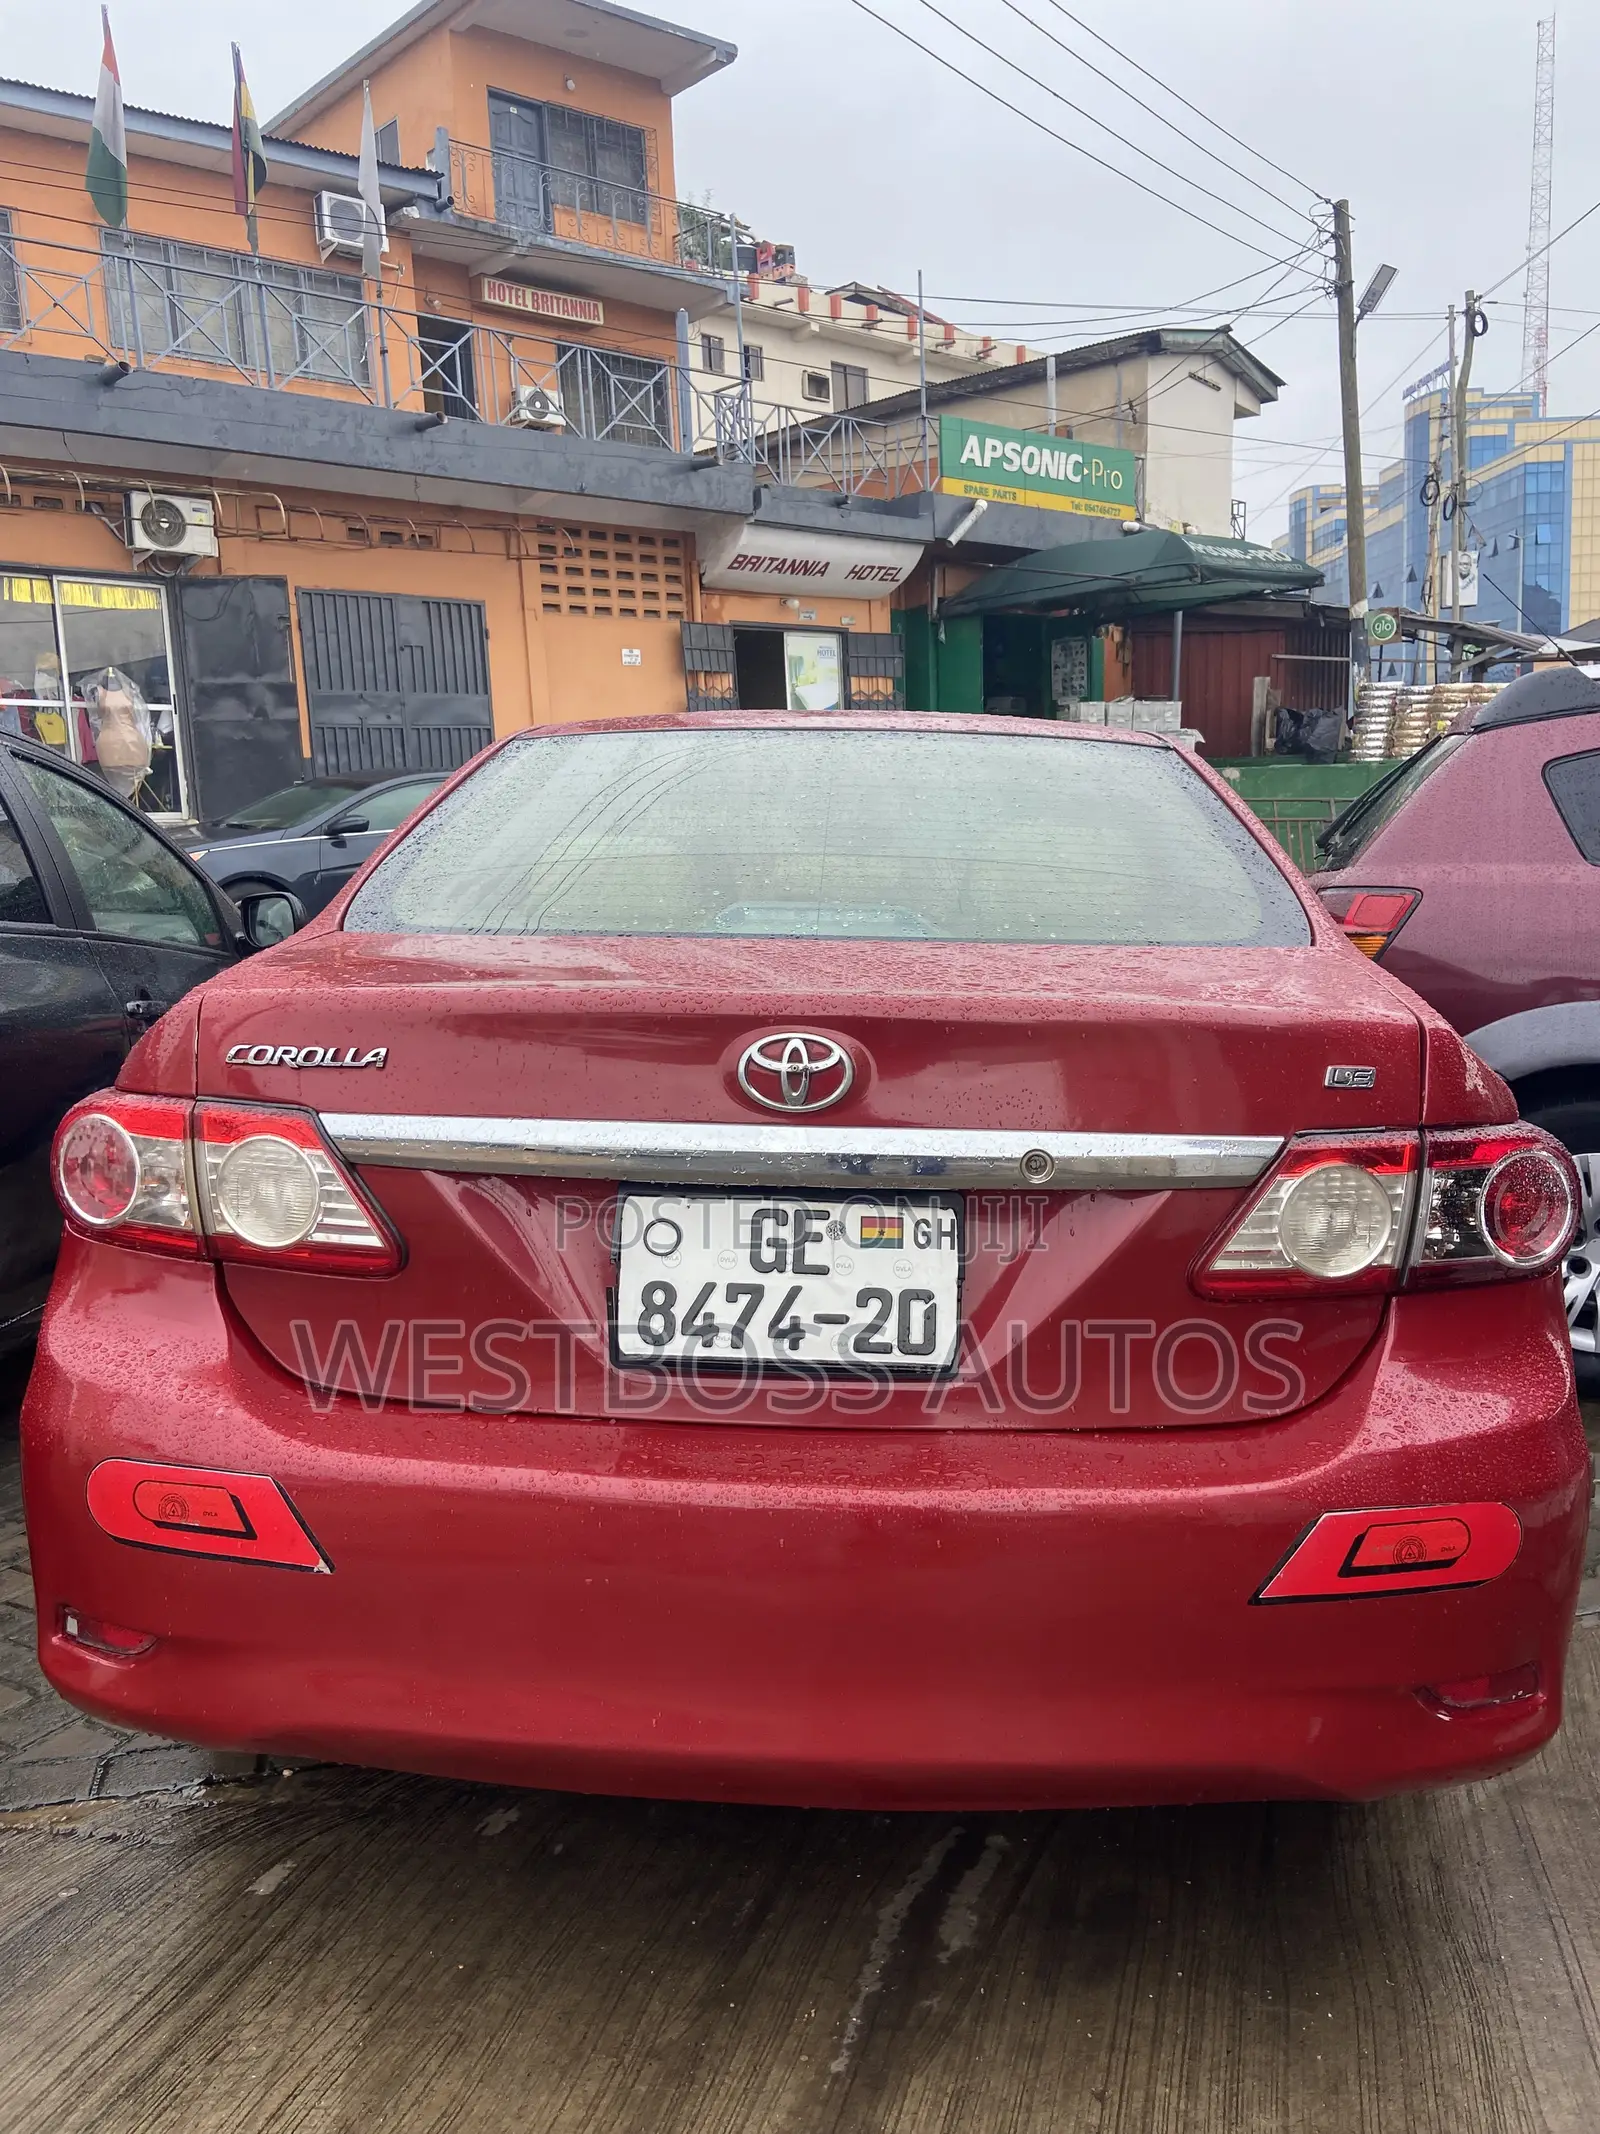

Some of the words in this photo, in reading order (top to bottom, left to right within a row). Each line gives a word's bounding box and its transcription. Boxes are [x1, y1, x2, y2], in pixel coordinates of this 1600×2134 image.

[488, 280, 528, 308] HOTEL
[531, 291, 600, 321] BRITANNIA
[960, 434, 1083, 483] APSONIC
[1091, 458, 1123, 490] Pro
[963, 484, 989, 497] SPARE
[992, 488, 1017, 501] PARTS
[727, 553, 831, 578] BRITANNIA
[844, 564, 902, 583] HOTEL
[1375, 622, 1392, 633] glo
[817, 649, 836, 657] HOTEL
[225, 1044, 388, 1069] COROLLA
[750, 1208, 830, 1275] GE
[913, 1218, 956, 1251] GH
[637, 1279, 938, 1355] 8474-20
